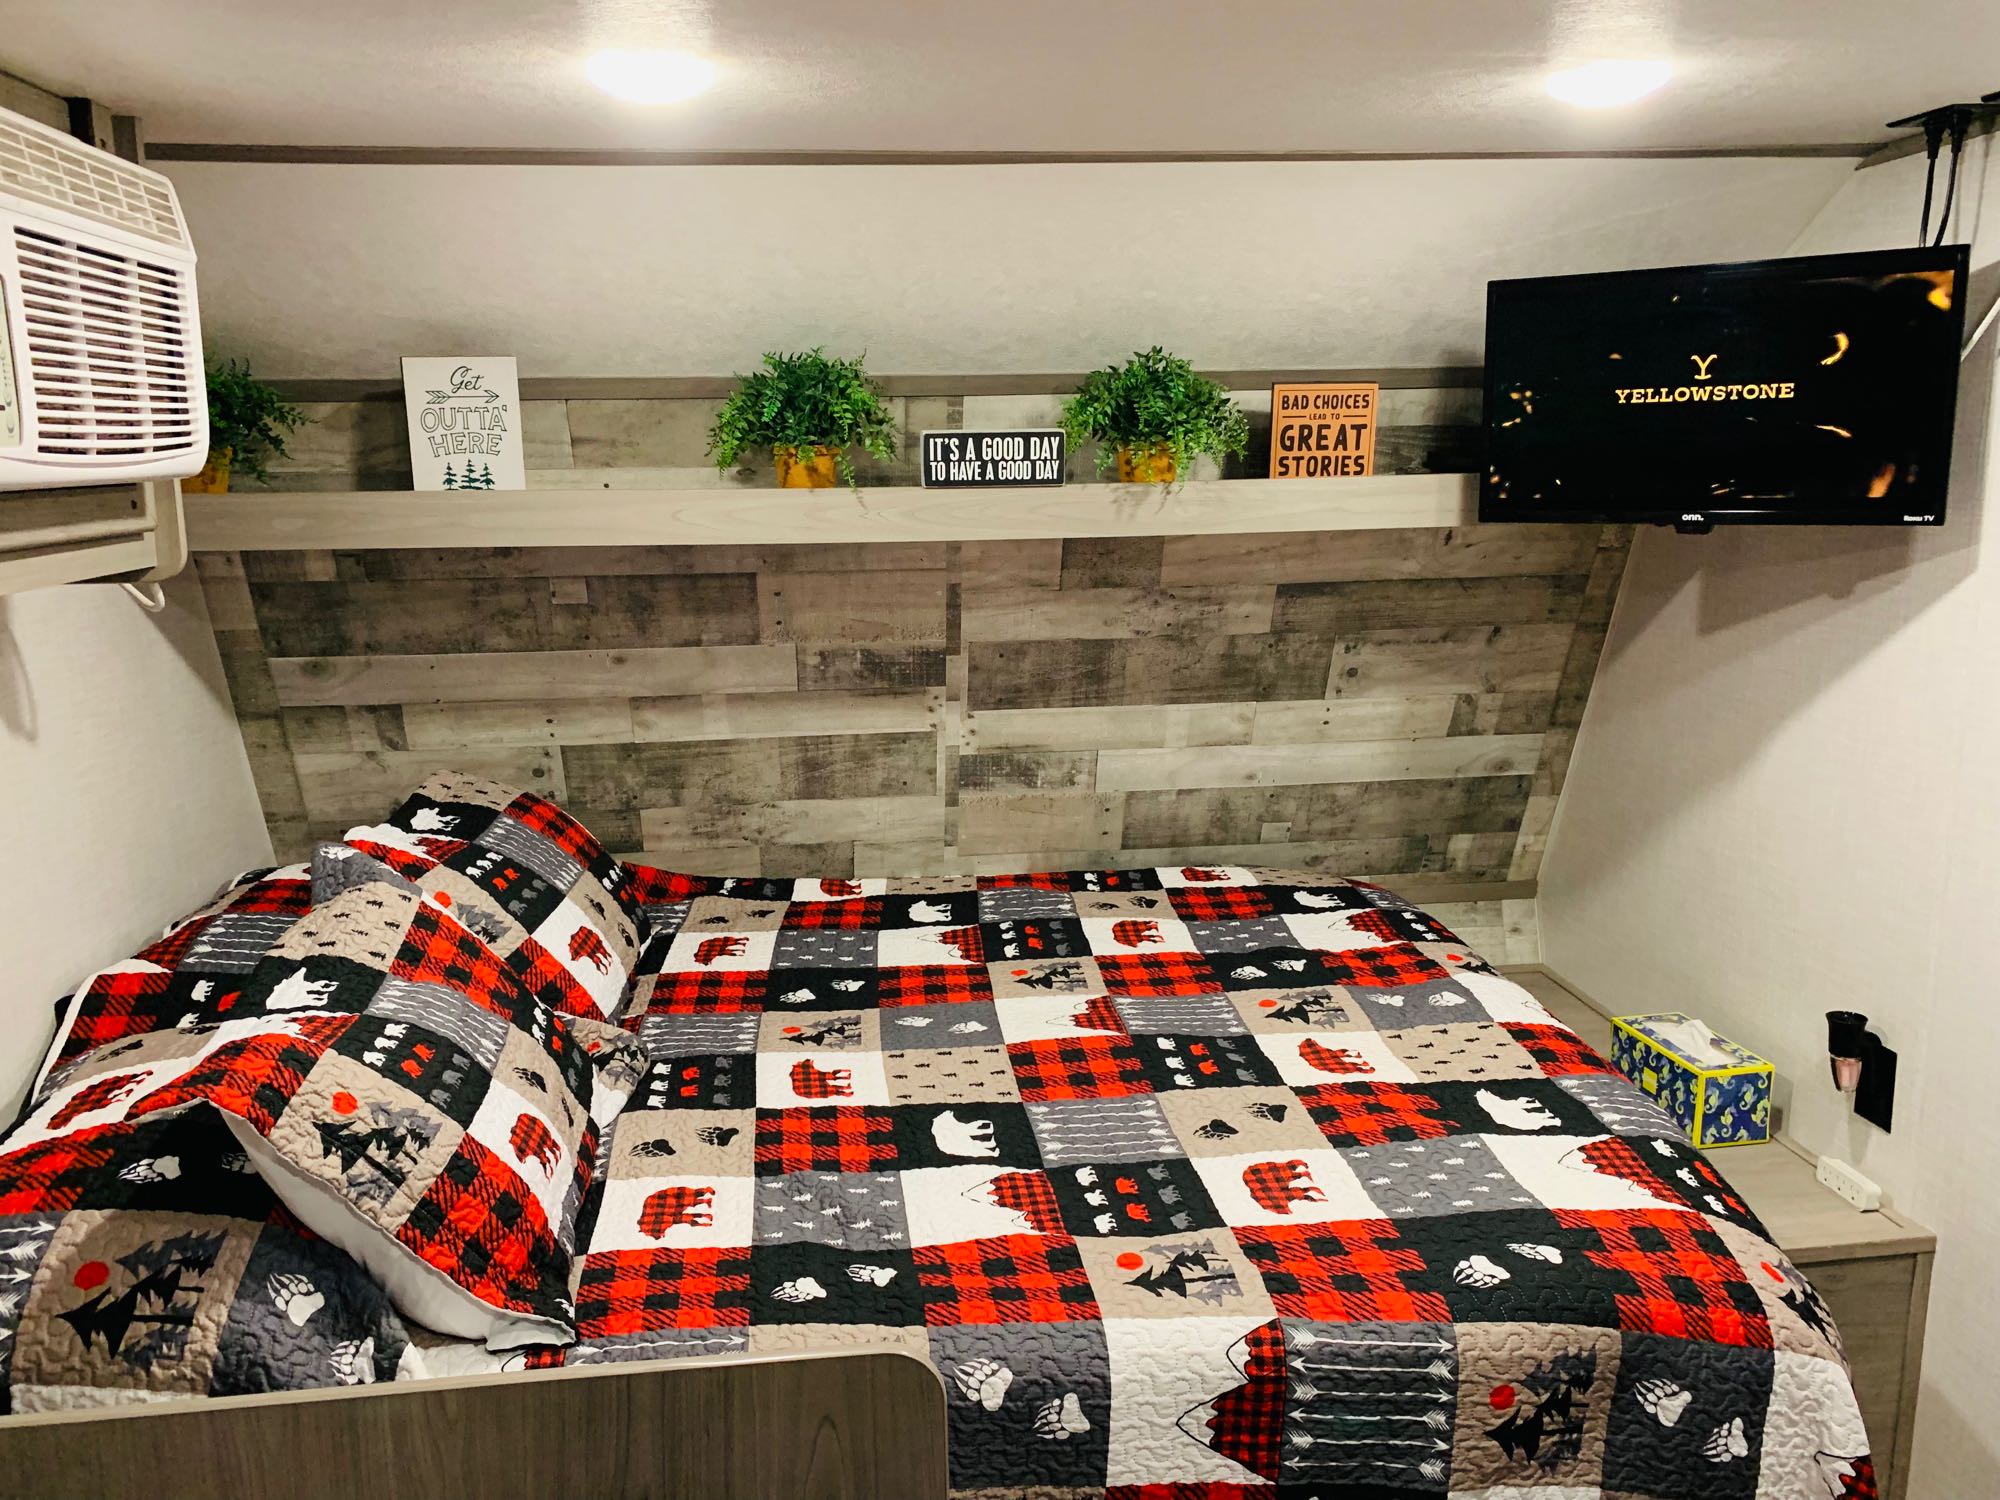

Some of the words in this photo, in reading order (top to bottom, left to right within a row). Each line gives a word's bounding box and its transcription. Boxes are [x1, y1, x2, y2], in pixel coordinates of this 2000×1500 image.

[1690, 354, 1718, 380] Y
[450, 366, 484, 394] Get
[1281, 394, 1310, 411] BAD
[1313, 394, 1370, 409] CHOICES
[1615, 382, 1795, 404] YELLOWSTONE
[1309, 413, 1327, 421] LEAD
[428, 431, 503, 458] HERE
[929, 437, 960, 462] IT'S
[965, 437, 976, 461] A
[982, 436, 1024, 461] GOOD
[1030, 436, 1060, 460] DAY
[1279, 423, 1368, 452] GREAT
[929, 461, 946, 481] TO
[950, 461, 982, 481] HAVE
[985, 461, 995, 480] A
[998, 460, 1032, 480] GOOD
[1035, 460, 1060, 480] DAY
[1278, 455, 1365, 478] STORIES
[1923, 514, 1935, 522] TV
